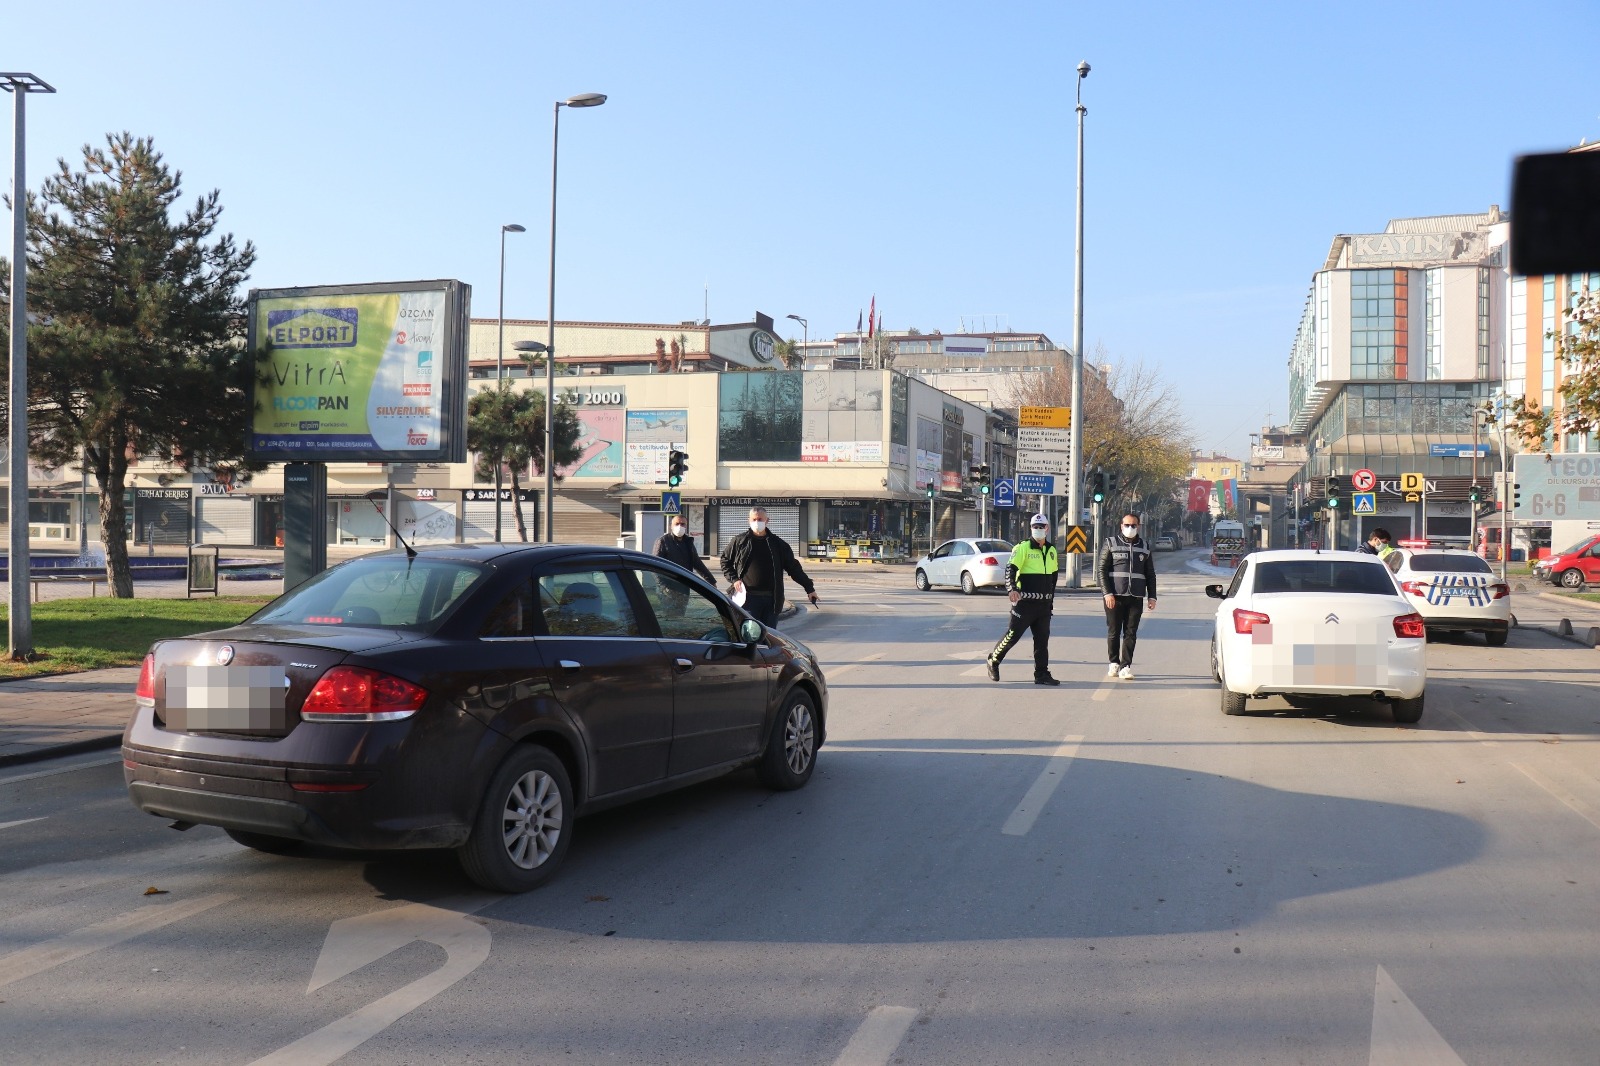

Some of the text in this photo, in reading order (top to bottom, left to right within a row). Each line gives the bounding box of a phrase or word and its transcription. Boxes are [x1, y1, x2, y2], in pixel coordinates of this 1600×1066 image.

[1354, 234, 1445, 256] KAYIN
[400, 308, 434, 318] ÖZCAN
[275, 326, 349, 343] ELPORT
[273, 360, 346, 386] VitrA
[273, 395, 349, 411] FLOORPAN
[584, 391, 621, 405] 2000
[376, 406, 431, 416] SILVERLINE
[1406, 474, 1418, 488] D
[137, 489, 189, 499] SERHAT SERBES
[417, 488, 434, 497] ZEN
[478, 490, 511, 500] SARAF
[999, 486, 1009, 498] P
[1379, 480, 1444, 497] KUN
[1532, 493, 1566, 516] 6+6
